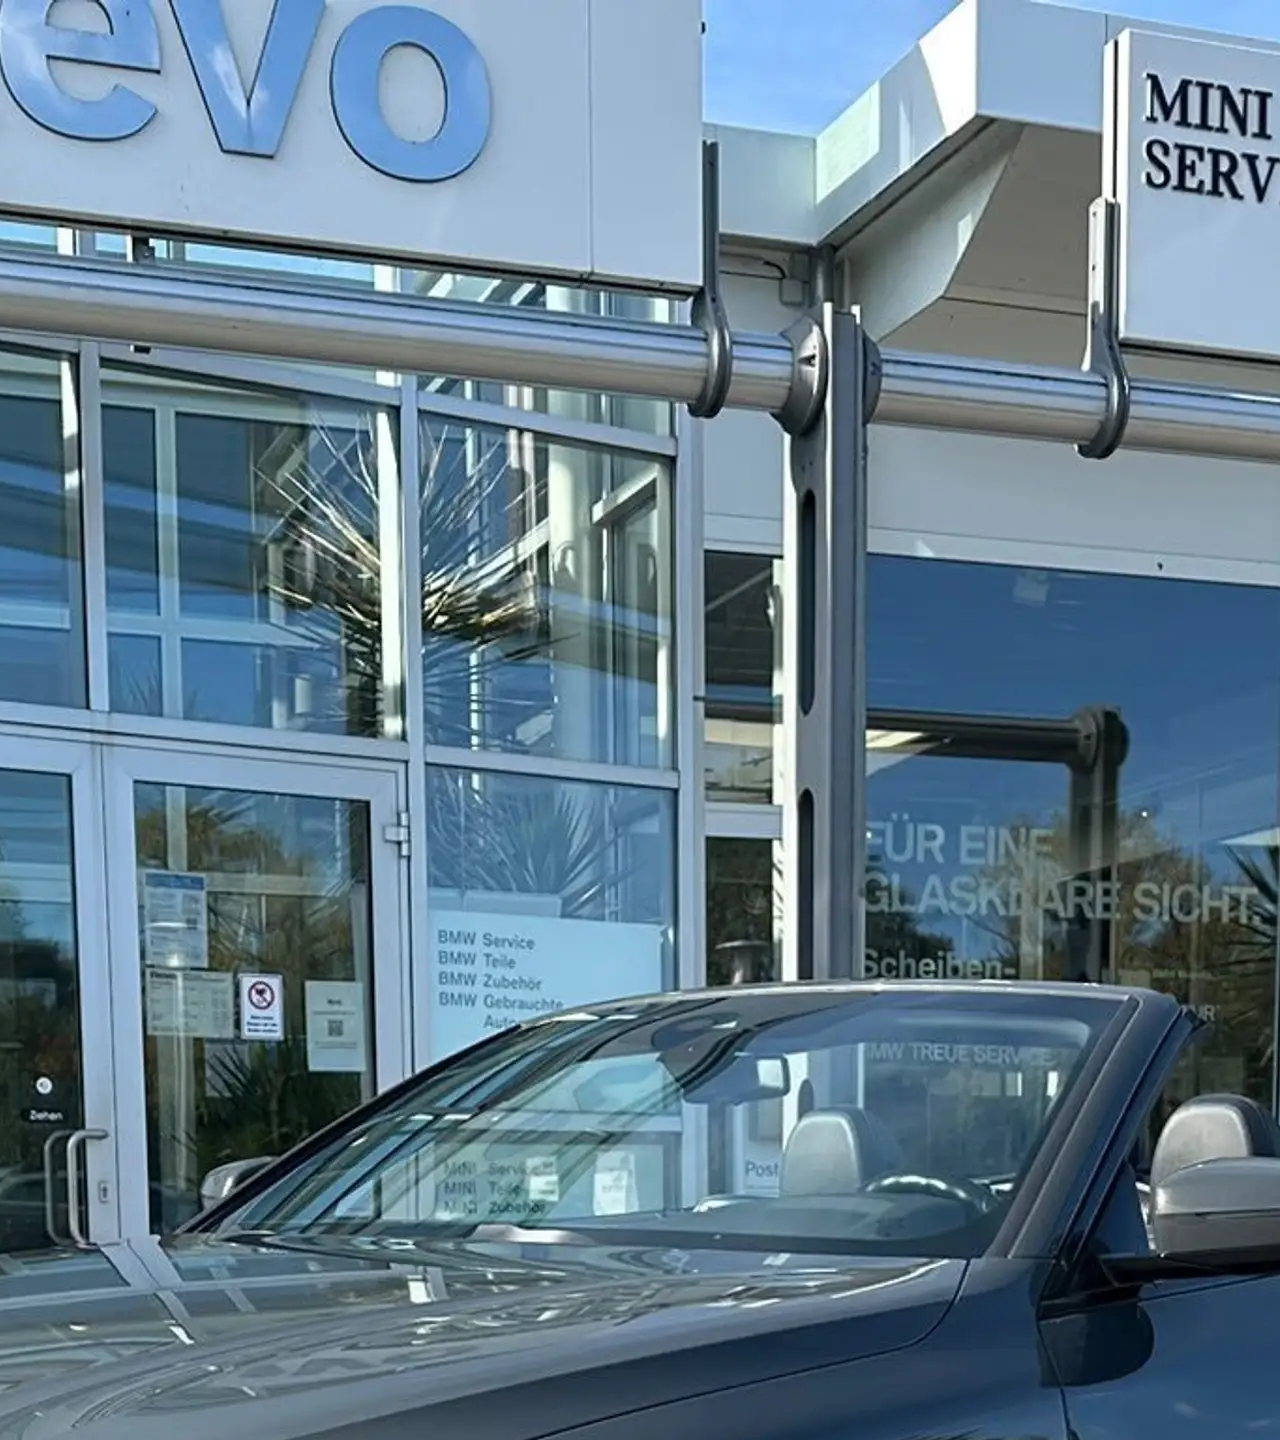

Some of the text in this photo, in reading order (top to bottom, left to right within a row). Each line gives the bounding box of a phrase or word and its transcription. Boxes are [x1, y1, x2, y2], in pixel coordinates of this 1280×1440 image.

[1144, 72, 1274, 141] MINI
[866, 812, 1054, 867] FÜR EINE
[438, 929, 536, 950] BMW Service
[438, 950, 517, 969] BMW Teile
[864, 948, 1016, 980] Scheiben-
[438, 970, 542, 991] BMW Zubehör
[438, 991, 564, 1011] BMW Gebrauchte
[908, 1043, 970, 1063] TREUE
[443, 1180, 477, 1195] MINI
